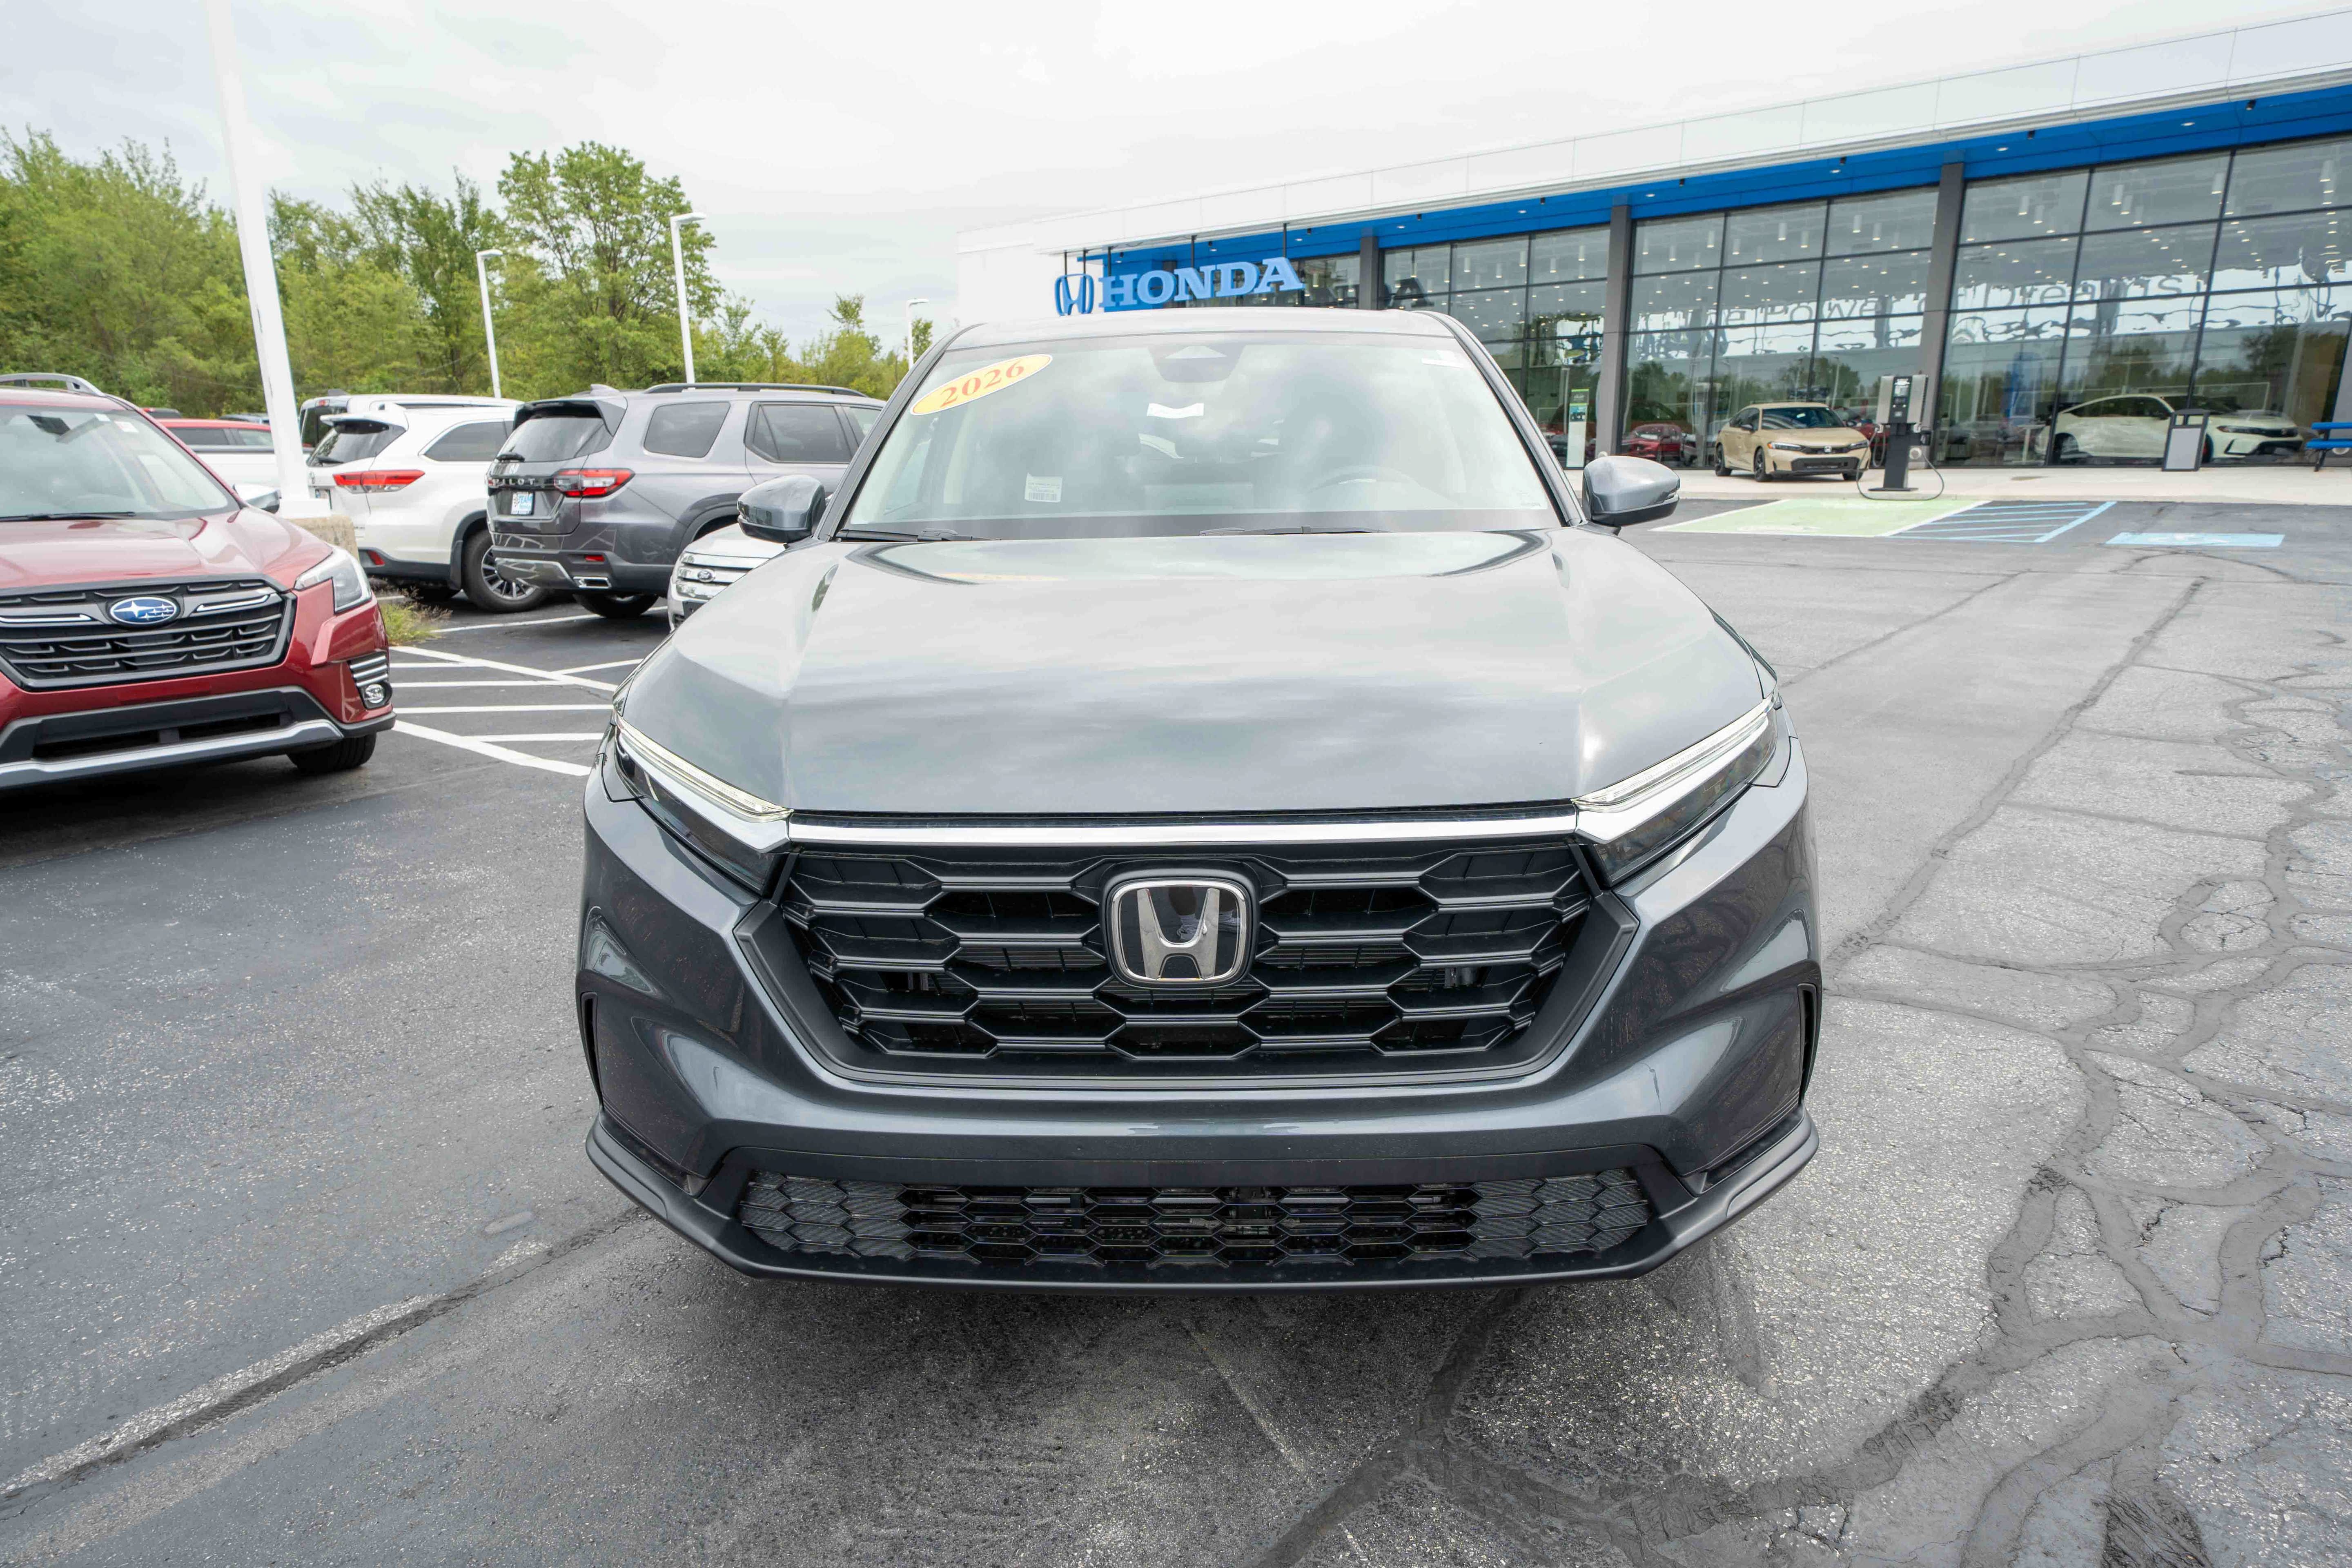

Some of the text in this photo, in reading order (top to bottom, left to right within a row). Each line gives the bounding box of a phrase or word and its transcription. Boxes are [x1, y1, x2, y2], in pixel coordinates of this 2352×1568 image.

[1098, 256, 1306, 308] HONDA
[940, 359, 1025, 408] 2026
[493, 478, 535, 486] PILOT
